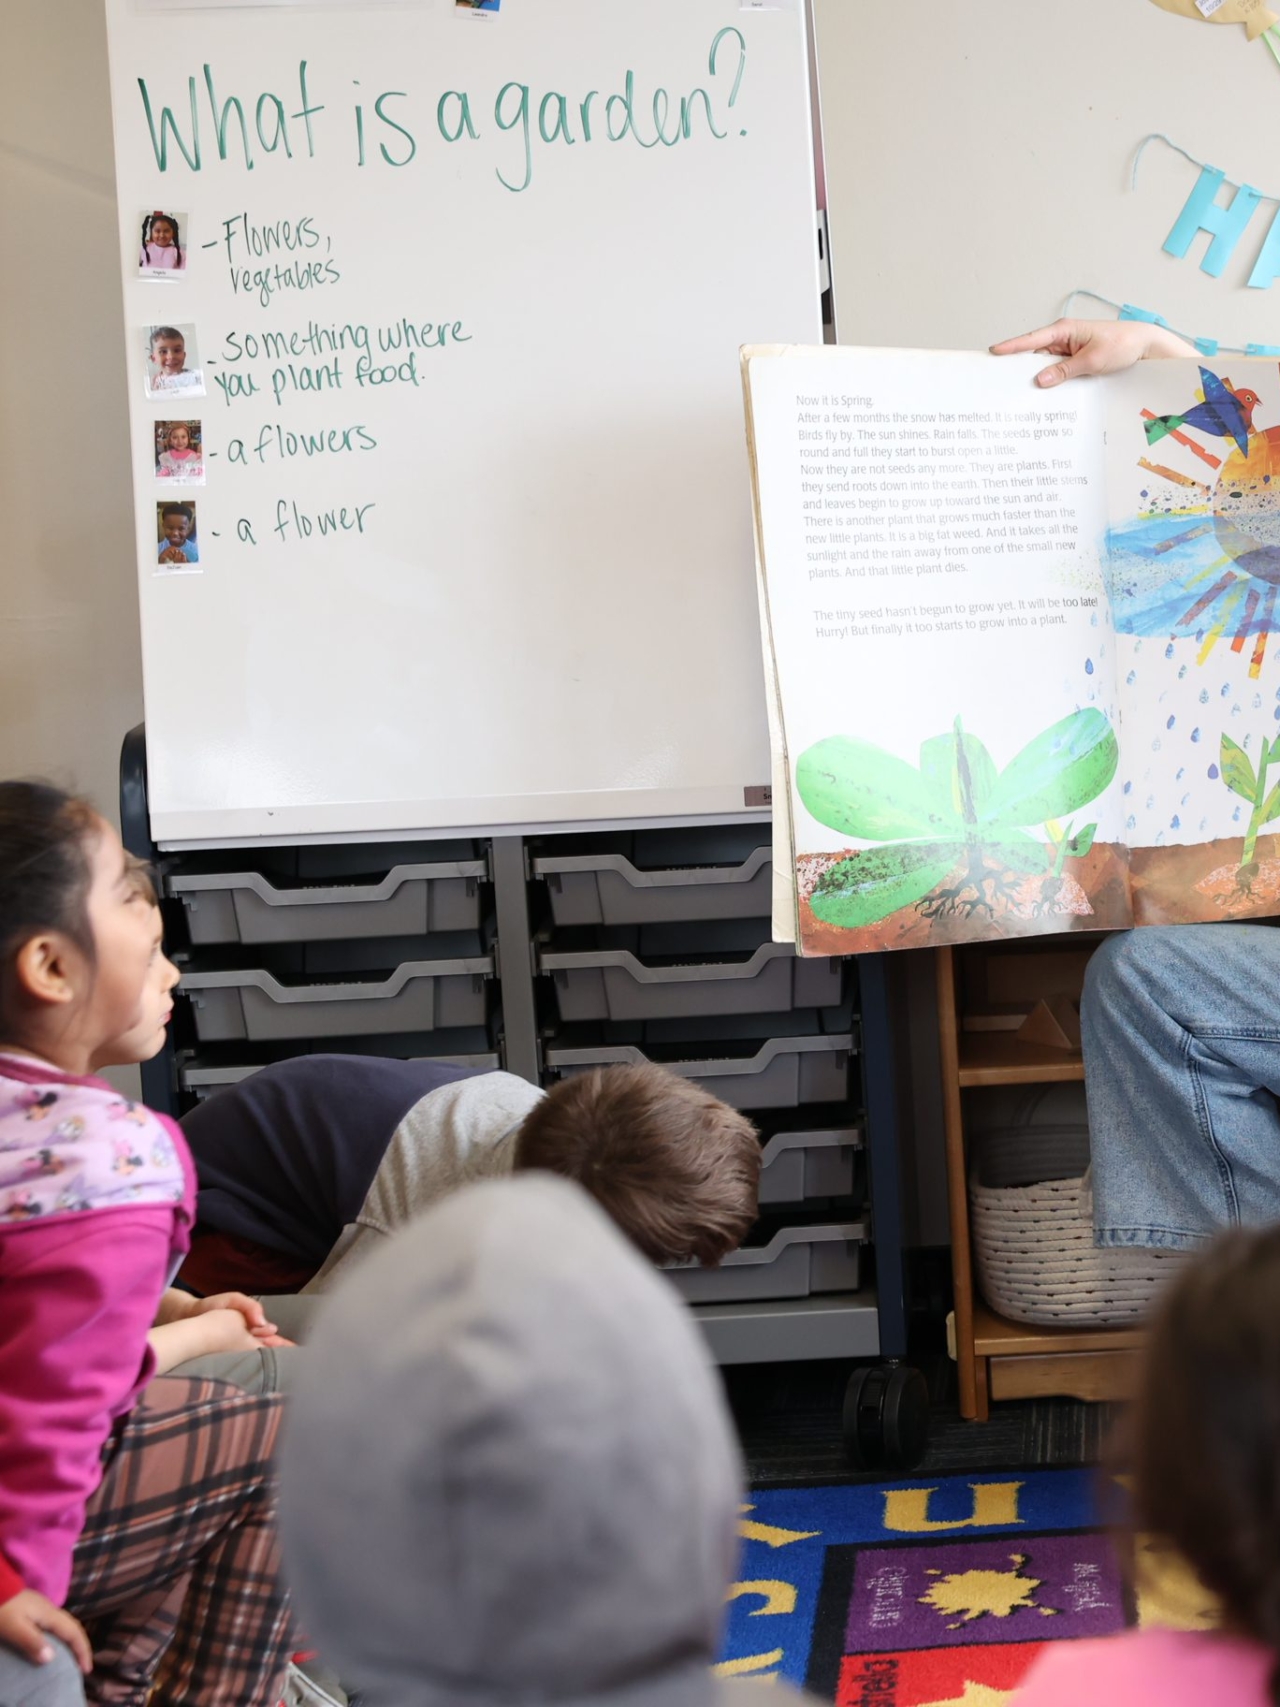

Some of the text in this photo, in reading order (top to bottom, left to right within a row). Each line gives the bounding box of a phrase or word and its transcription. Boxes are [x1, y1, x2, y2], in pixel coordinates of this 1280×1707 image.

[137, 27, 747, 192] What is a garden?
[379, 318, 473, 352] where
[214, 351, 426, 406] you plant food.
[796, 395, 819, 405] Now
[831, 395, 839, 406] is
[797, 413, 820, 423] After
[824, 415, 830, 423] a
[832, 413, 850, 423] few
[853, 413, 890, 423] months
[892, 412, 908, 422] the
[911, 414, 936, 423] snow
[939, 412, 955, 422] has
[1014, 412, 1041, 424] really
[798, 430, 823, 440] Birds
[825, 430, 837, 443] fly
[857, 429, 876, 440] The
[878, 431, 896, 440] sun
[933, 427, 955, 439] Rain
[1033, 429, 1058, 440] grow
[228, 425, 377, 465] a flowers
[800, 444, 955, 459] round and full they start to burst
[800, 463, 824, 474] Now
[826, 463, 848, 477] they
[850, 464, 867, 474] are
[869, 462, 886, 474] not
[888, 461, 916, 474] seeds
[997, 461, 1014, 471] are
[1051, 459, 1073, 469] First
[801, 474, 1088, 494] they send roots down Then their little stems
[803, 499, 822, 509] and
[824, 497, 856, 509] leaves
[858, 496, 886, 511] begin
[945, 493, 981, 506] toward
[983, 493, 1000, 504] the
[1002, 495, 1021, 504] sun
[1023, 492, 1043, 503] and
[237, 500, 376, 545] a flower
[803, 507, 1076, 526] There much faster than the
[805, 533, 827, 544] new
[829, 531, 851, 543] little
[936, 527, 950, 539] fat
[986, 527, 1007, 537] And
[1009, 525, 1016, 536] it
[1018, 524, 1046, 536] takes
[1048, 524, 1060, 534] all
[1062, 524, 1078, 533] the
[806, 541, 1076, 563] sunlight and away from one of the small new
[916, 564, 942, 577] plant
[919, 603, 953, 617] begun
[954, 602, 966, 613] to
[968, 604, 994, 615] grow
[1018, 600, 1026, 609] It
[1027, 598, 1046, 609] will
[1047, 598, 1060, 608] be
[1062, 598, 1079, 607] too
[850, 623, 868, 636] But
[906, 621, 913, 633] it
[915, 620, 933, 632] too
[935, 619, 963, 631] starts
[965, 618, 976, 629] to
[979, 619, 1004, 631] grow
[1008, 616, 1028, 626] into
[1030, 617, 1037, 625] a
